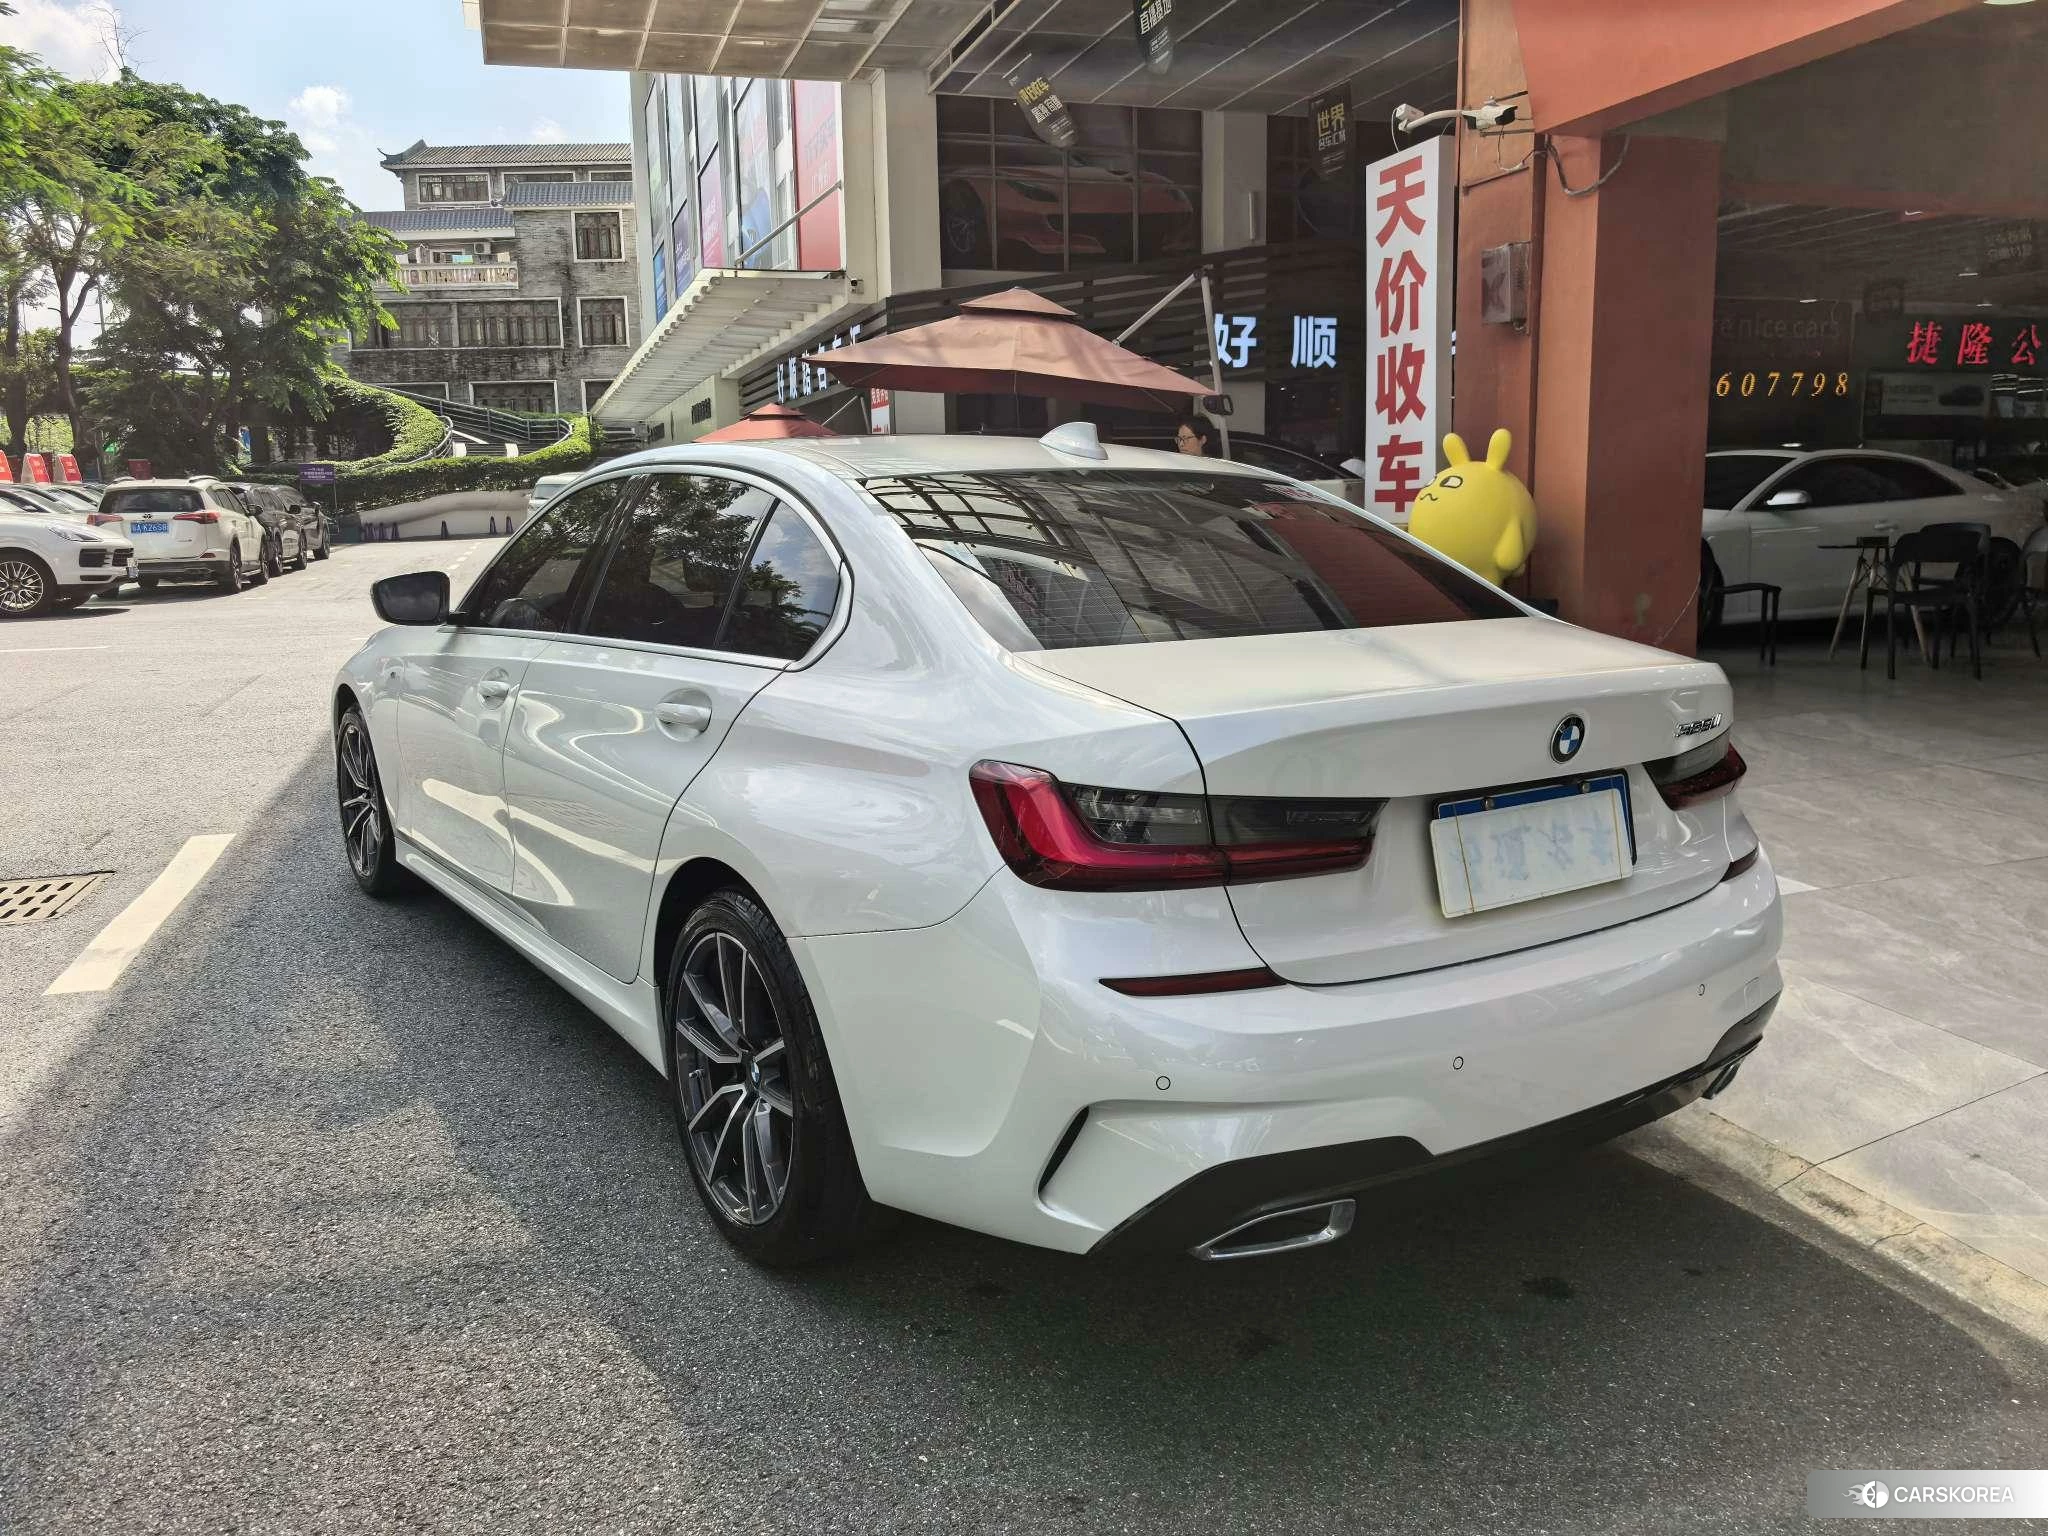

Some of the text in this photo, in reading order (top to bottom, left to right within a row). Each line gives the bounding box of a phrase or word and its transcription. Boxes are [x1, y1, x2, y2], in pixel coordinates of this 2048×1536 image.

[1318, 103, 1345, 137] 世界
[1214, 313, 1338, 369] 好顺
[1375, 155, 1427, 513] 天价收车
[1906, 320, 2042, 367] 捷隆公
[1715, 371, 1850, 398] 607798
